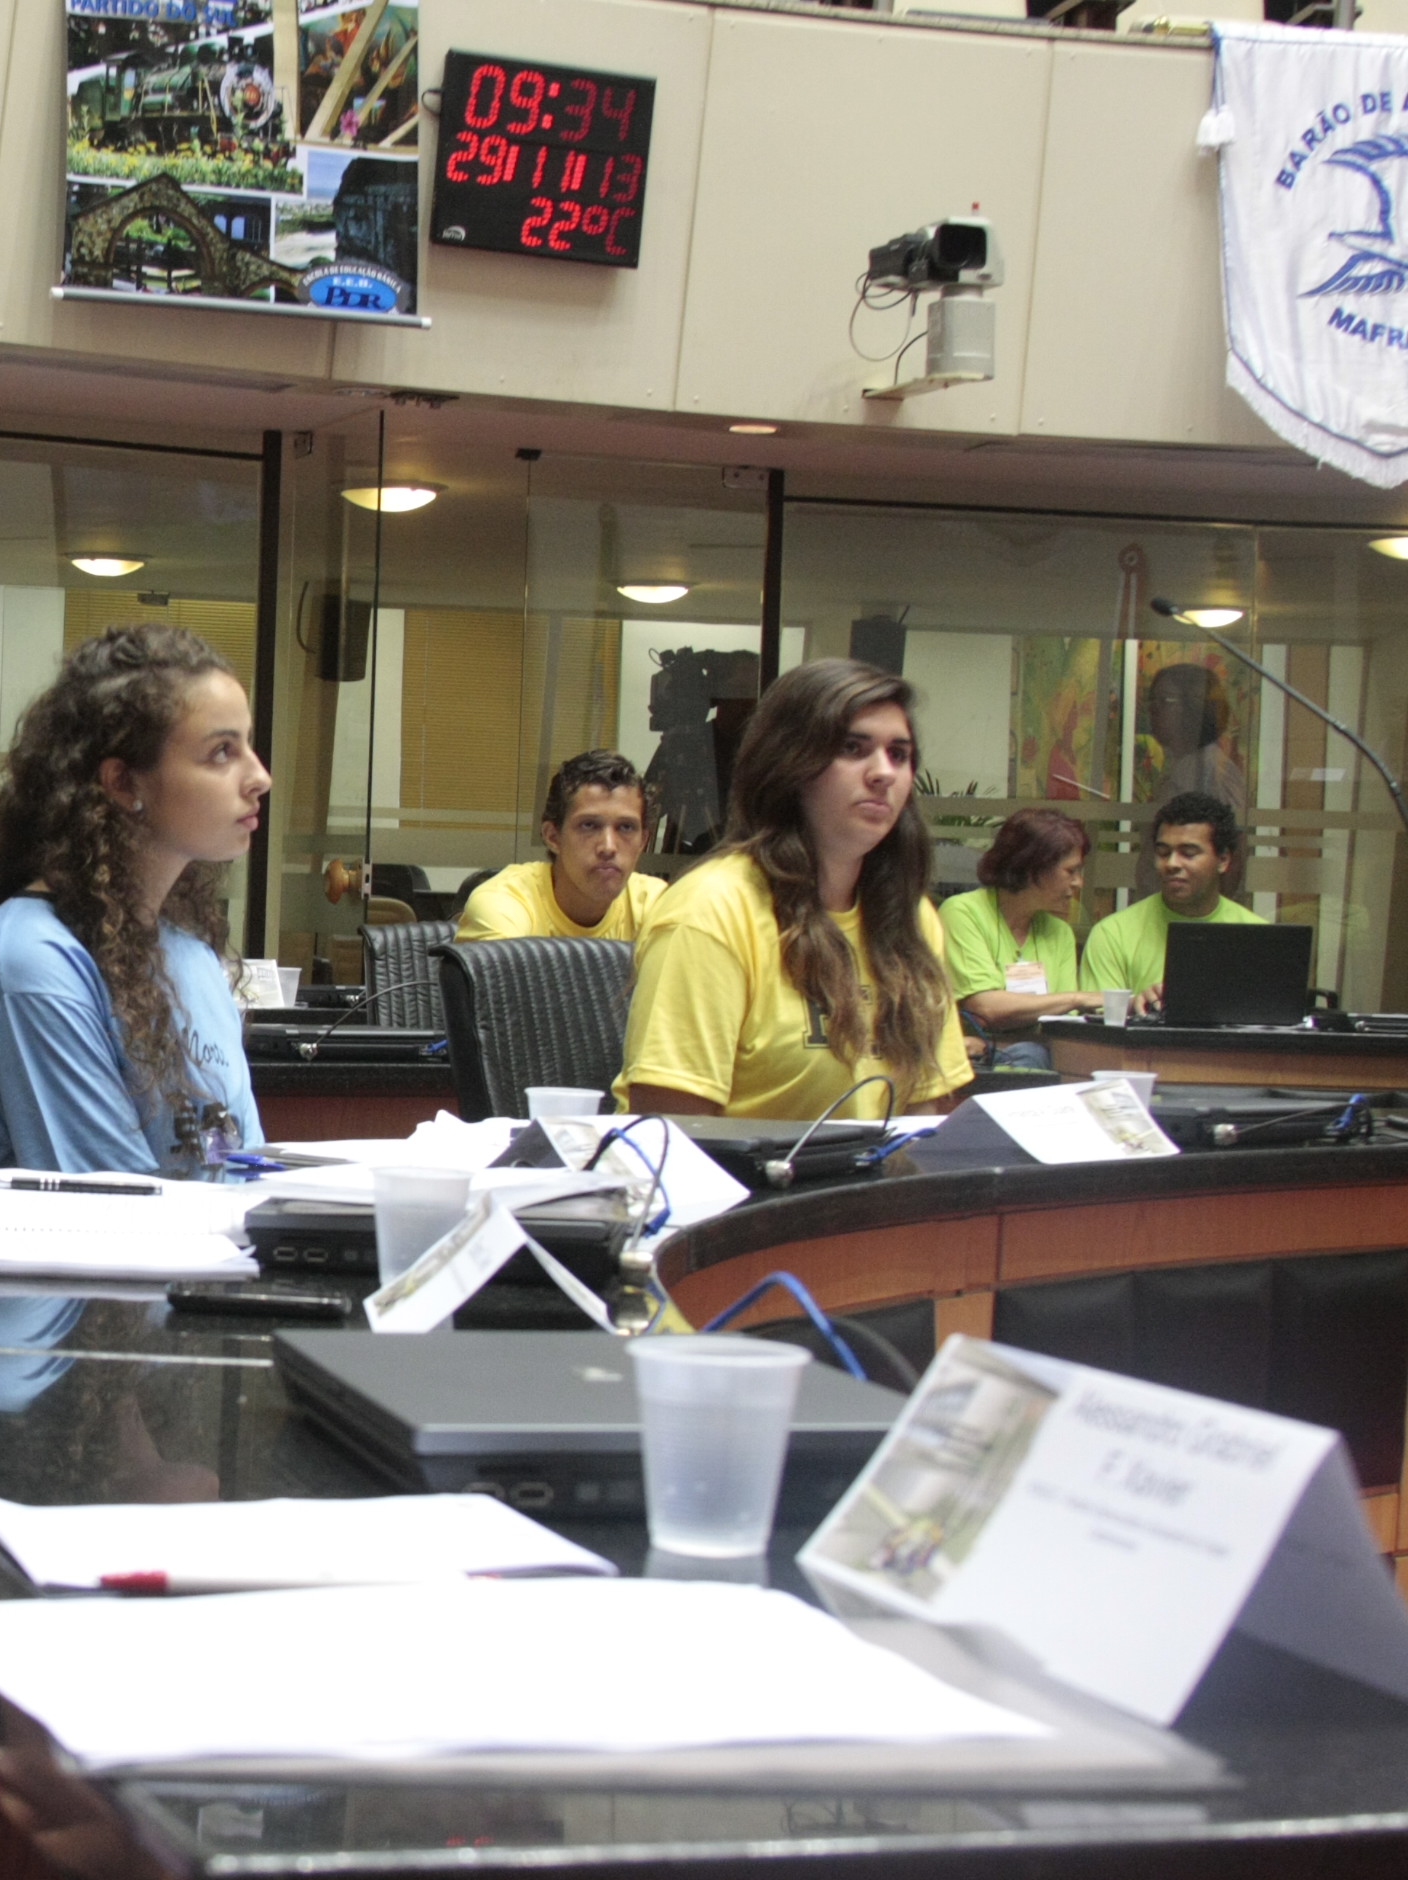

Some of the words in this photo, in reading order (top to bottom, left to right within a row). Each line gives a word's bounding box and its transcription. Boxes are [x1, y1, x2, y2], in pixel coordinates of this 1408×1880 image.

[70, 0, 159, 18] PARTIDO
[165, 1, 197, 22] DO
[204, 6, 236, 27] SUL
[464, 63, 637, 142] 09:34
[1275, 102, 1351, 191] BARÃO
[1360, 91, 1392, 114] DE
